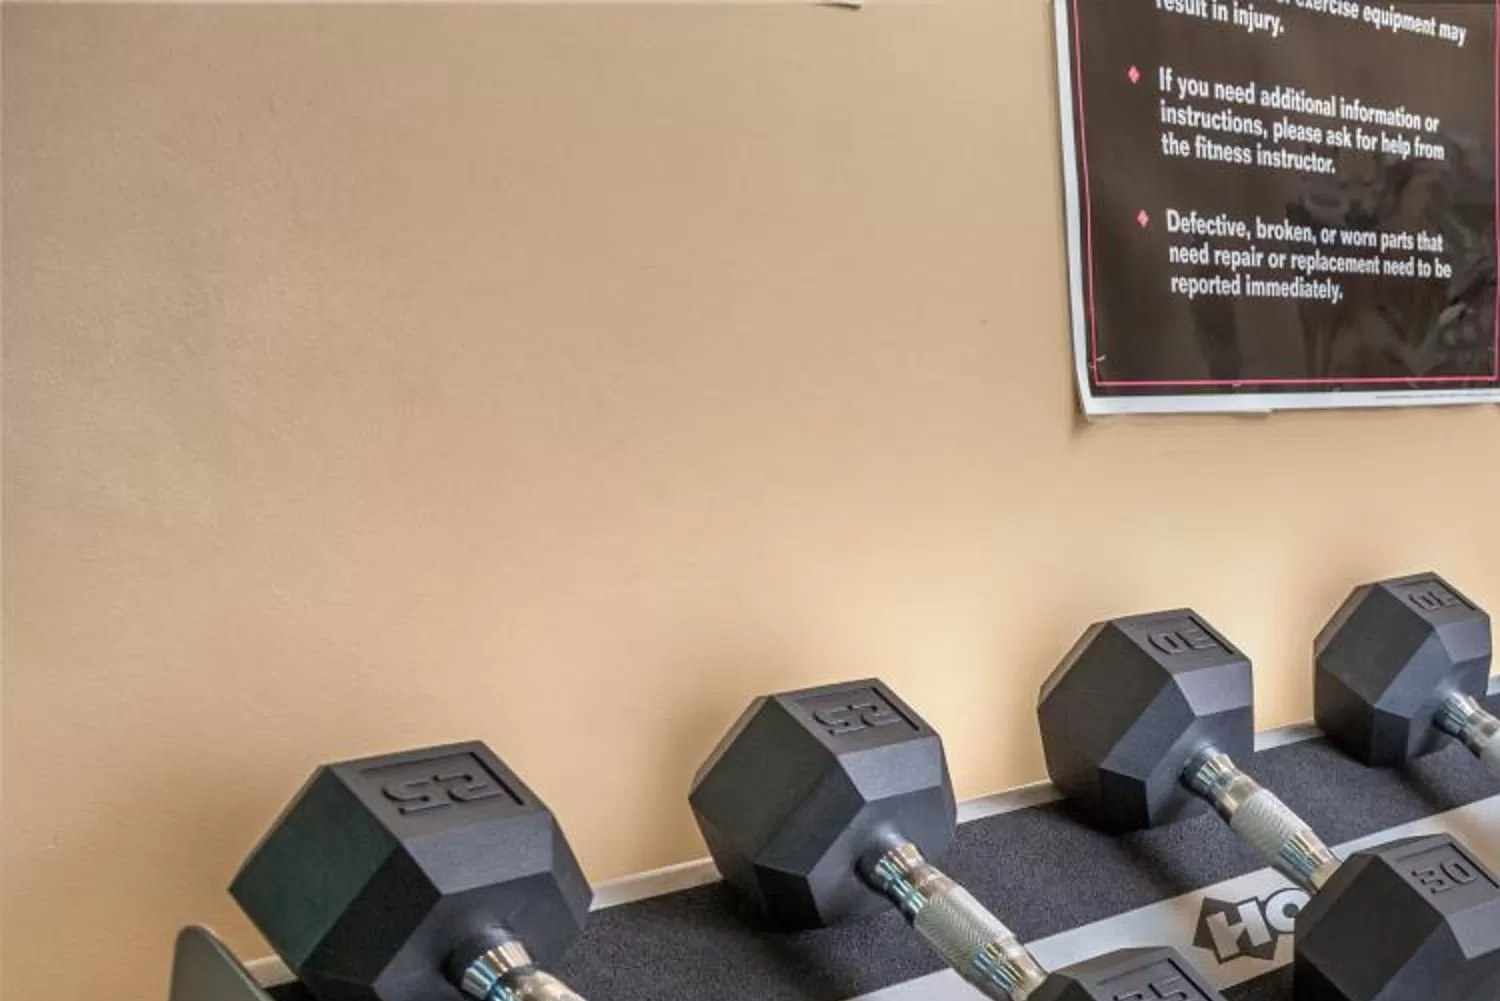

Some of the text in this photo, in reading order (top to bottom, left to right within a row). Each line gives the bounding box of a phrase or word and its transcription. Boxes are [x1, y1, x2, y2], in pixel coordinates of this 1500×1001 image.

[1212, 0, 1229, 22] in
[1233, 1, 1285, 38] injury.
[1363, 4, 1437, 36] equipment
[1439, 21, 1467, 47] may
[1159, 66, 1440, 133] If you need additional information or
[1160, 99, 1446, 161] instructions, please ask for help from
[1161, 131, 1336, 175] the fitness instructor.
[1166, 208, 1444, 254] Defective, broken, or worn parts that
[1169, 241, 1453, 280] need repair or replacement need to be
[1171, 273, 1343, 305] reported immediately.
[812, 703, 904, 737] 25
[380, 771, 503, 817] 25
[1410, 861, 1478, 895] 30
